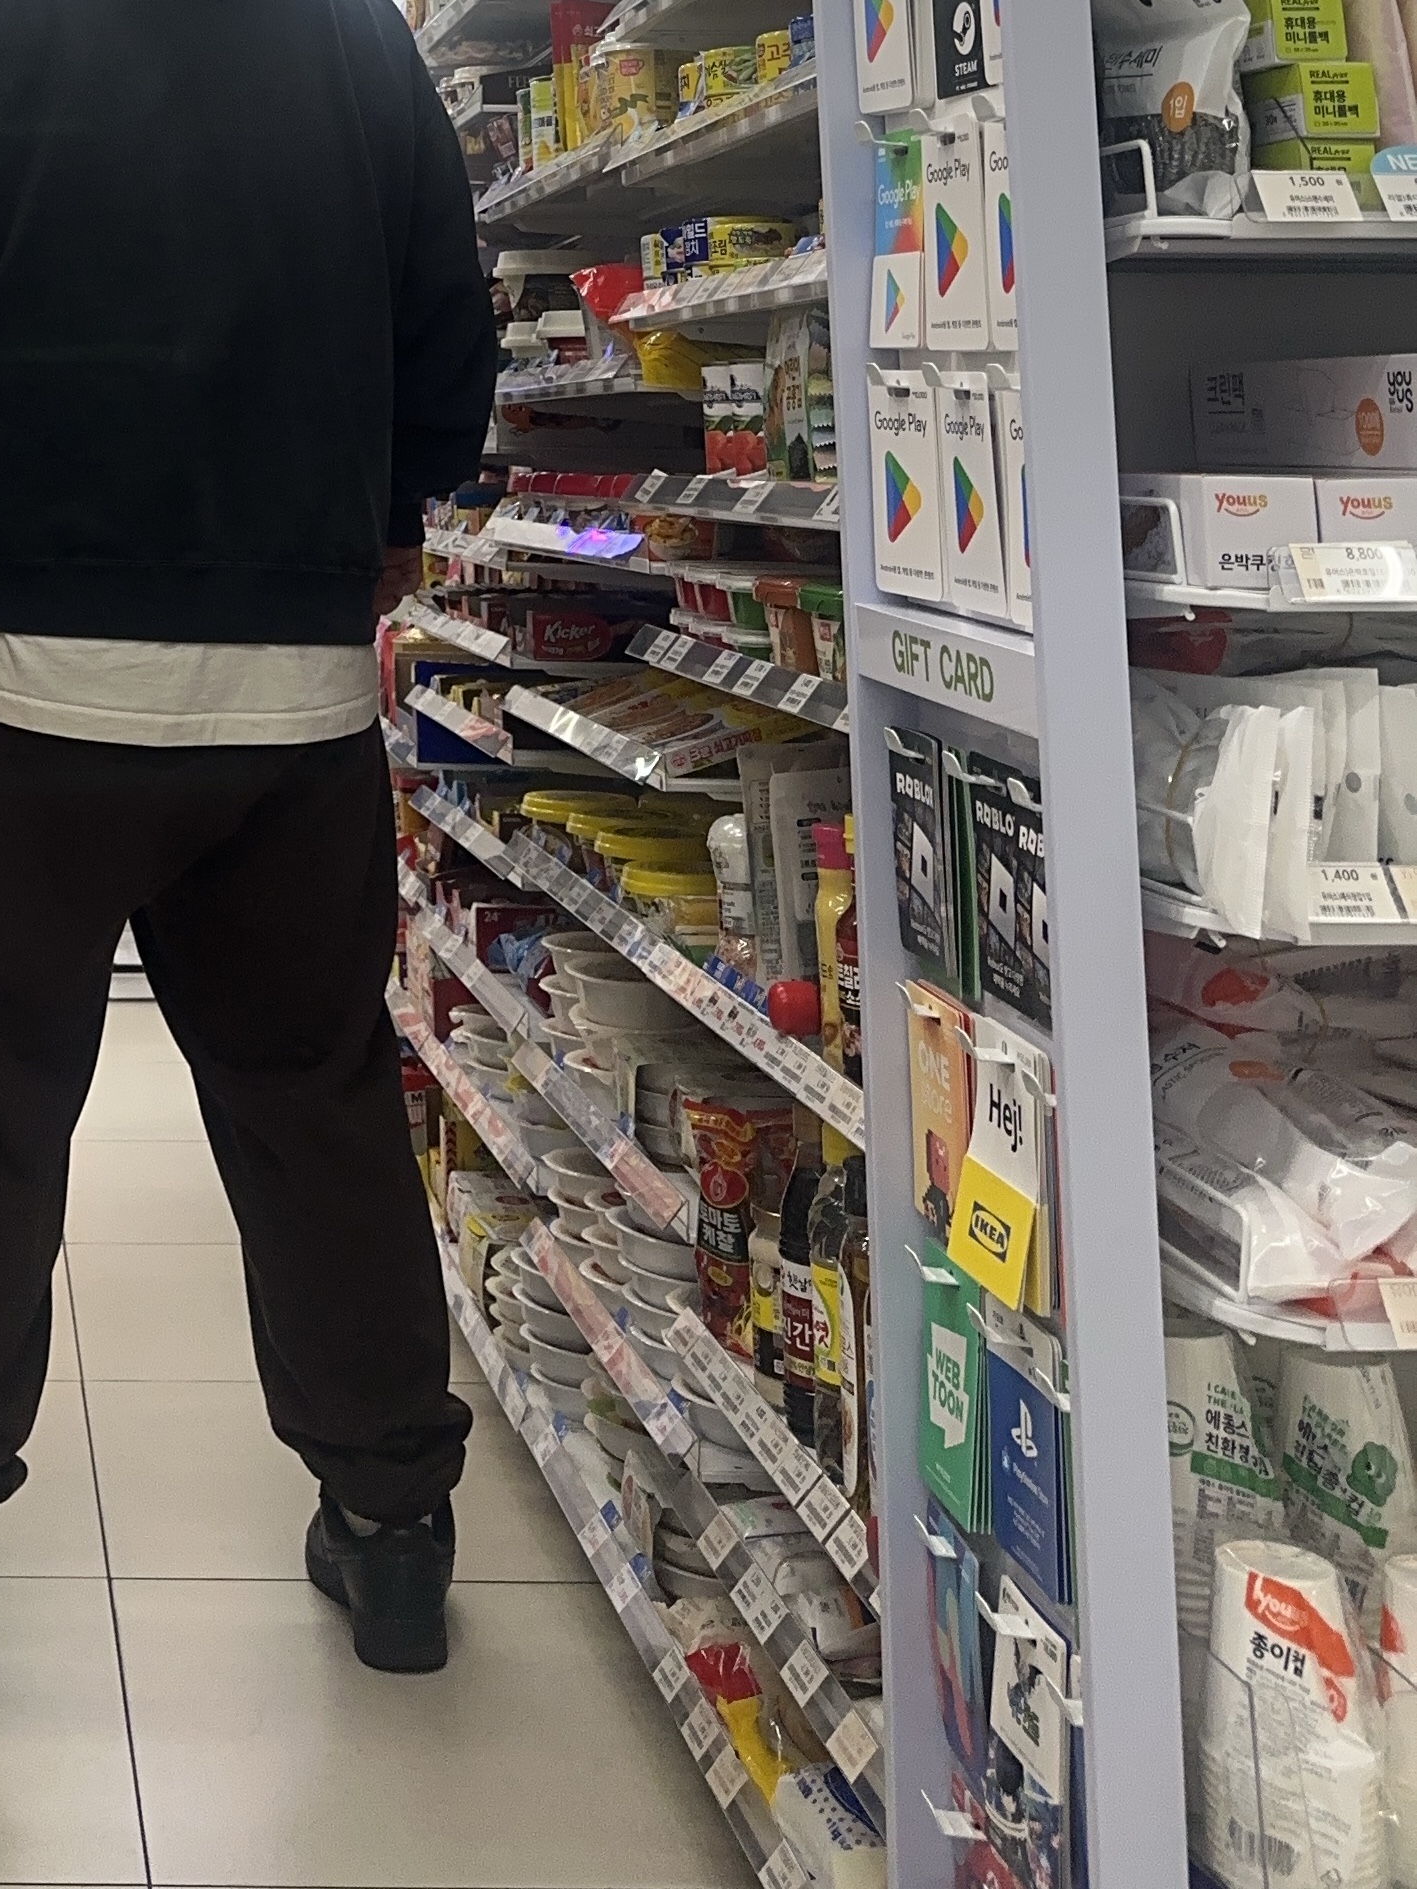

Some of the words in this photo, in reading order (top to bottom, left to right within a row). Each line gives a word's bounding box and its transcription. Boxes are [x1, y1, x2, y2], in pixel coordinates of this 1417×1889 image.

[1284, 16, 1317, 31] 휴대용
[954, 59, 979, 78] STEAM
[1312, 90, 1347, 104] 휴대용
[926, 160, 954, 187] Google
[954, 157, 971, 183] Play
[1288, 175, 1326, 189] 1,500
[877, 184, 905, 209] Google
[874, 410, 907, 437] Google
[908, 412, 928, 438] Play
[944, 413, 969, 441] Google
[969, 414, 984, 443] Play
[891, 629, 932, 683] GIFT
[939, 643, 995, 704] CARD
[1320, 868, 1360, 882] 1,400
[988, 1083, 1024, 1154] Hej!
[974, 1214, 1006, 1250] IKEA
[935, 1346, 961, 1393] WEB
[932, 1368, 965, 1425] TOON
[1249, 1630, 1307, 1679] 종이컵
